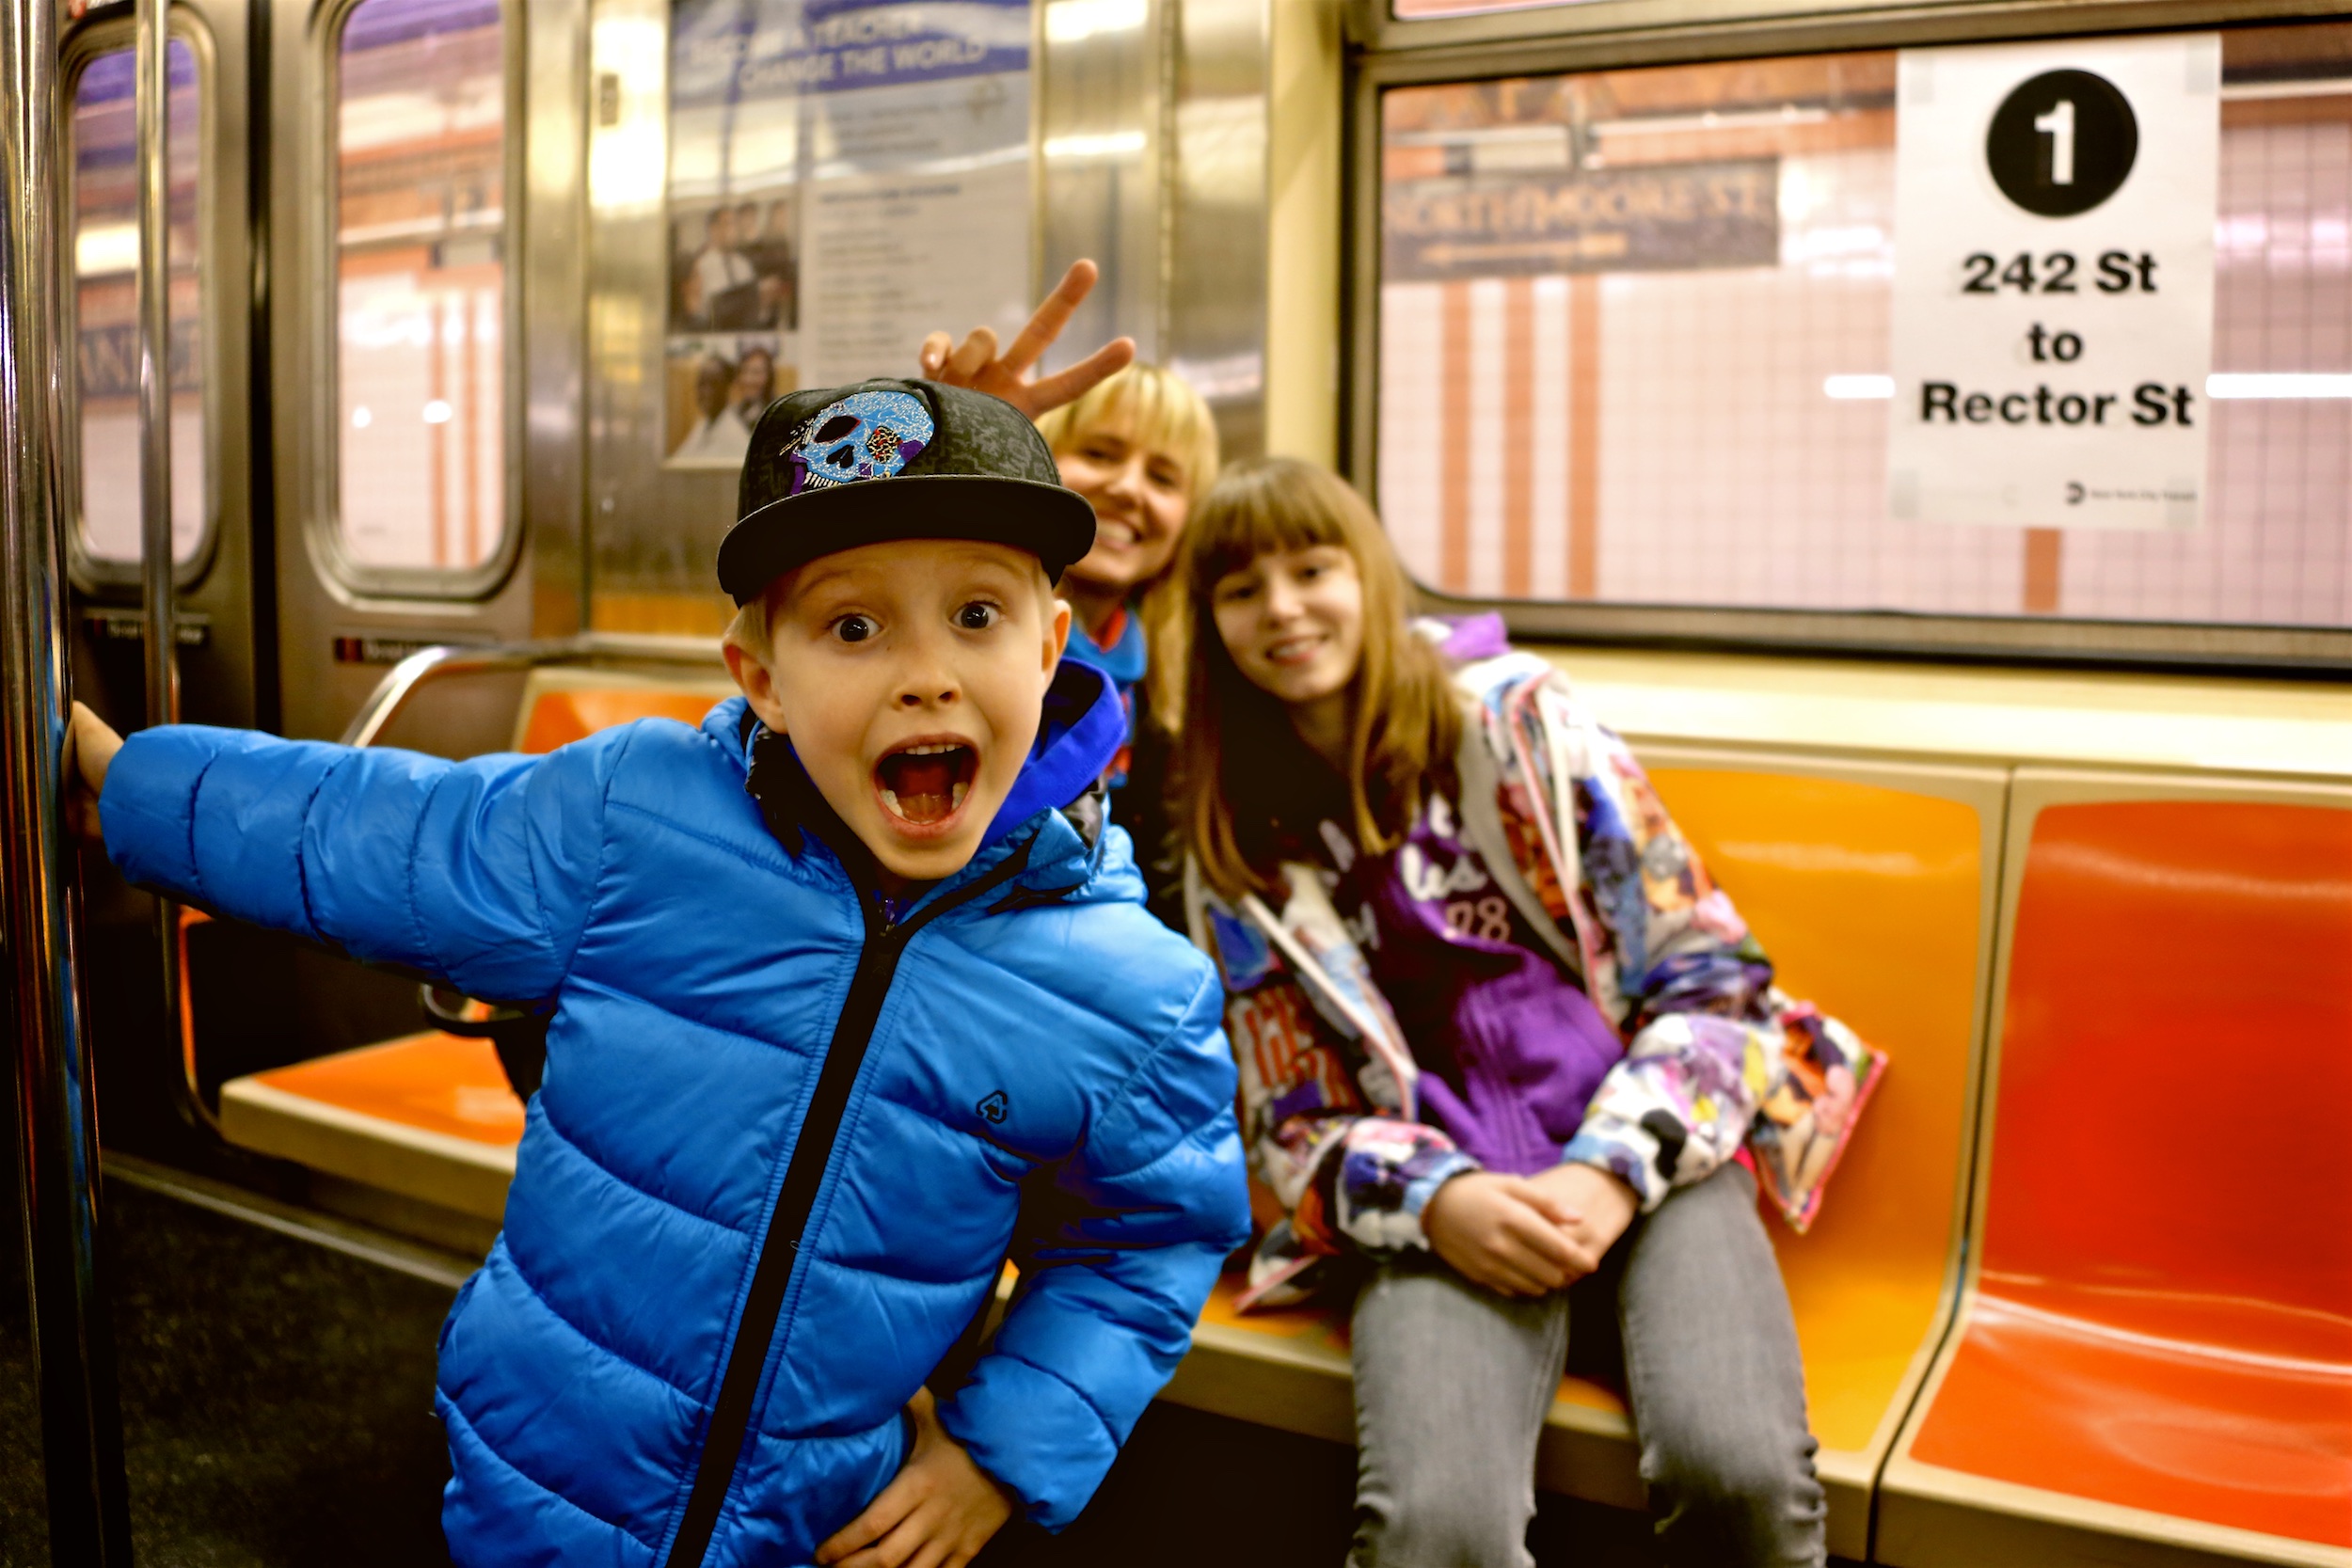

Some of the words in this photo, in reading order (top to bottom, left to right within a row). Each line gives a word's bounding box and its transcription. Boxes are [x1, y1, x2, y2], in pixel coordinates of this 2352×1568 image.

[738, 54, 835, 88] CHANGE
[840, 47, 887, 75] THE
[892, 36, 987, 69] WORLD
[2033, 99, 2075, 185] 1
[1961, 251, 2079, 294] 242
[2094, 250, 2159, 294] St
[2026, 323, 2085, 363] to
[1920, 381, 2116, 426] Rector
[2131, 382, 2196, 427] St
